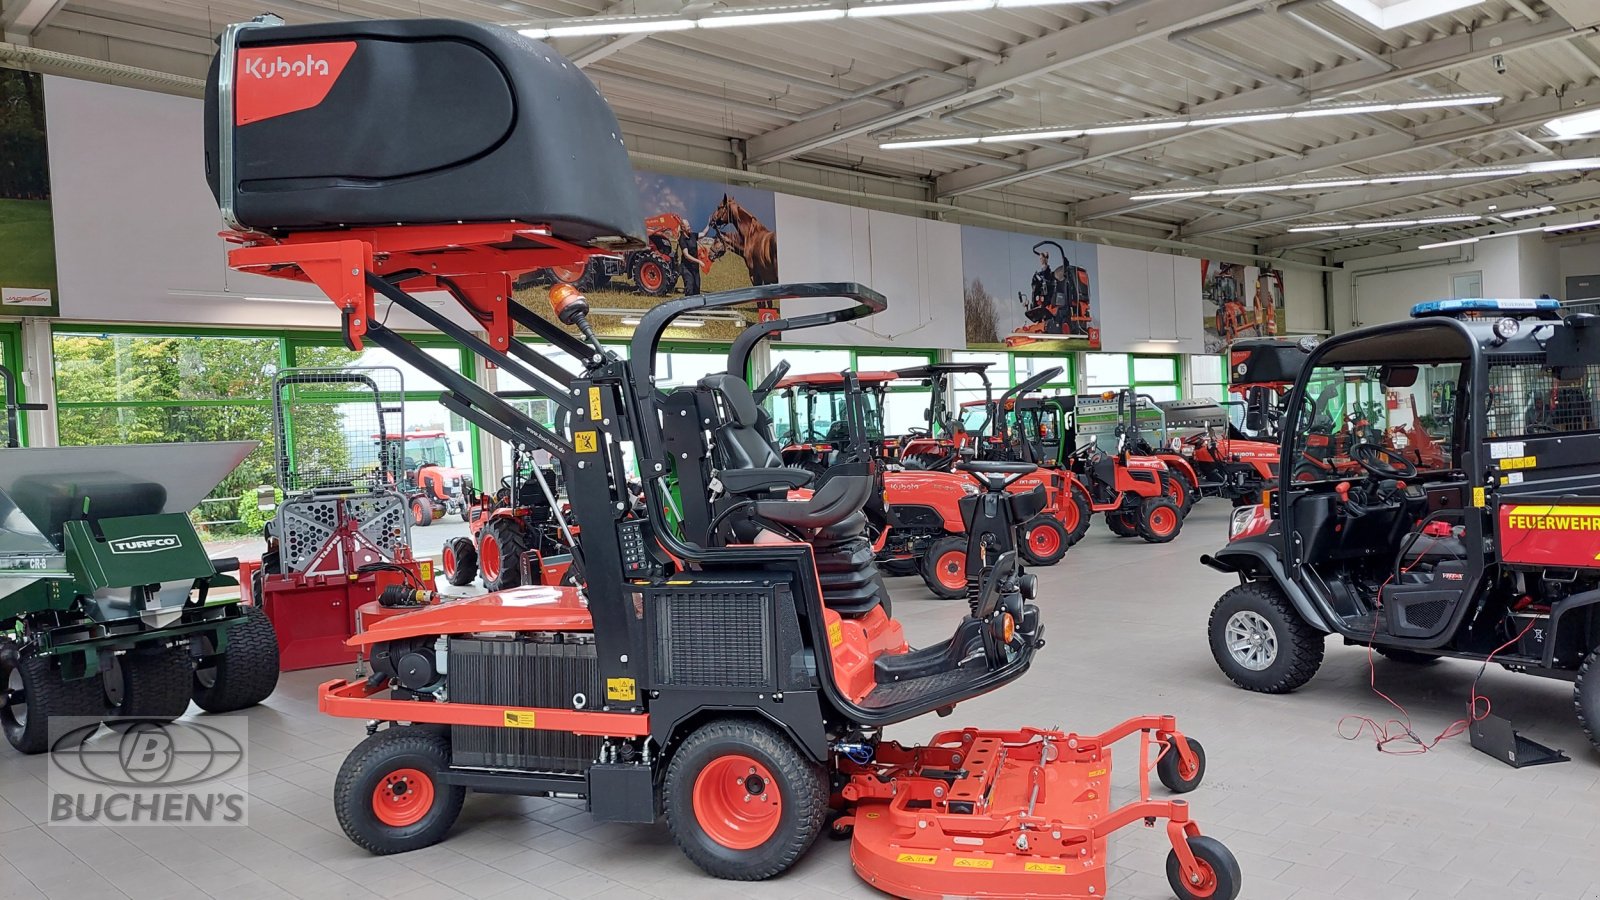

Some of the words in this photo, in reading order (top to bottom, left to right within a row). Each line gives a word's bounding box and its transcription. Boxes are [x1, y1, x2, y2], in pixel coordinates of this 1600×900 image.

[245, 54, 329, 79] Kubota
[889, 482, 920, 490] Kubota
[1508, 515, 1600, 531] FEUERWEHR
[115, 537, 175, 551] TURFCO
[29, 558, 48, 569] CR-8
